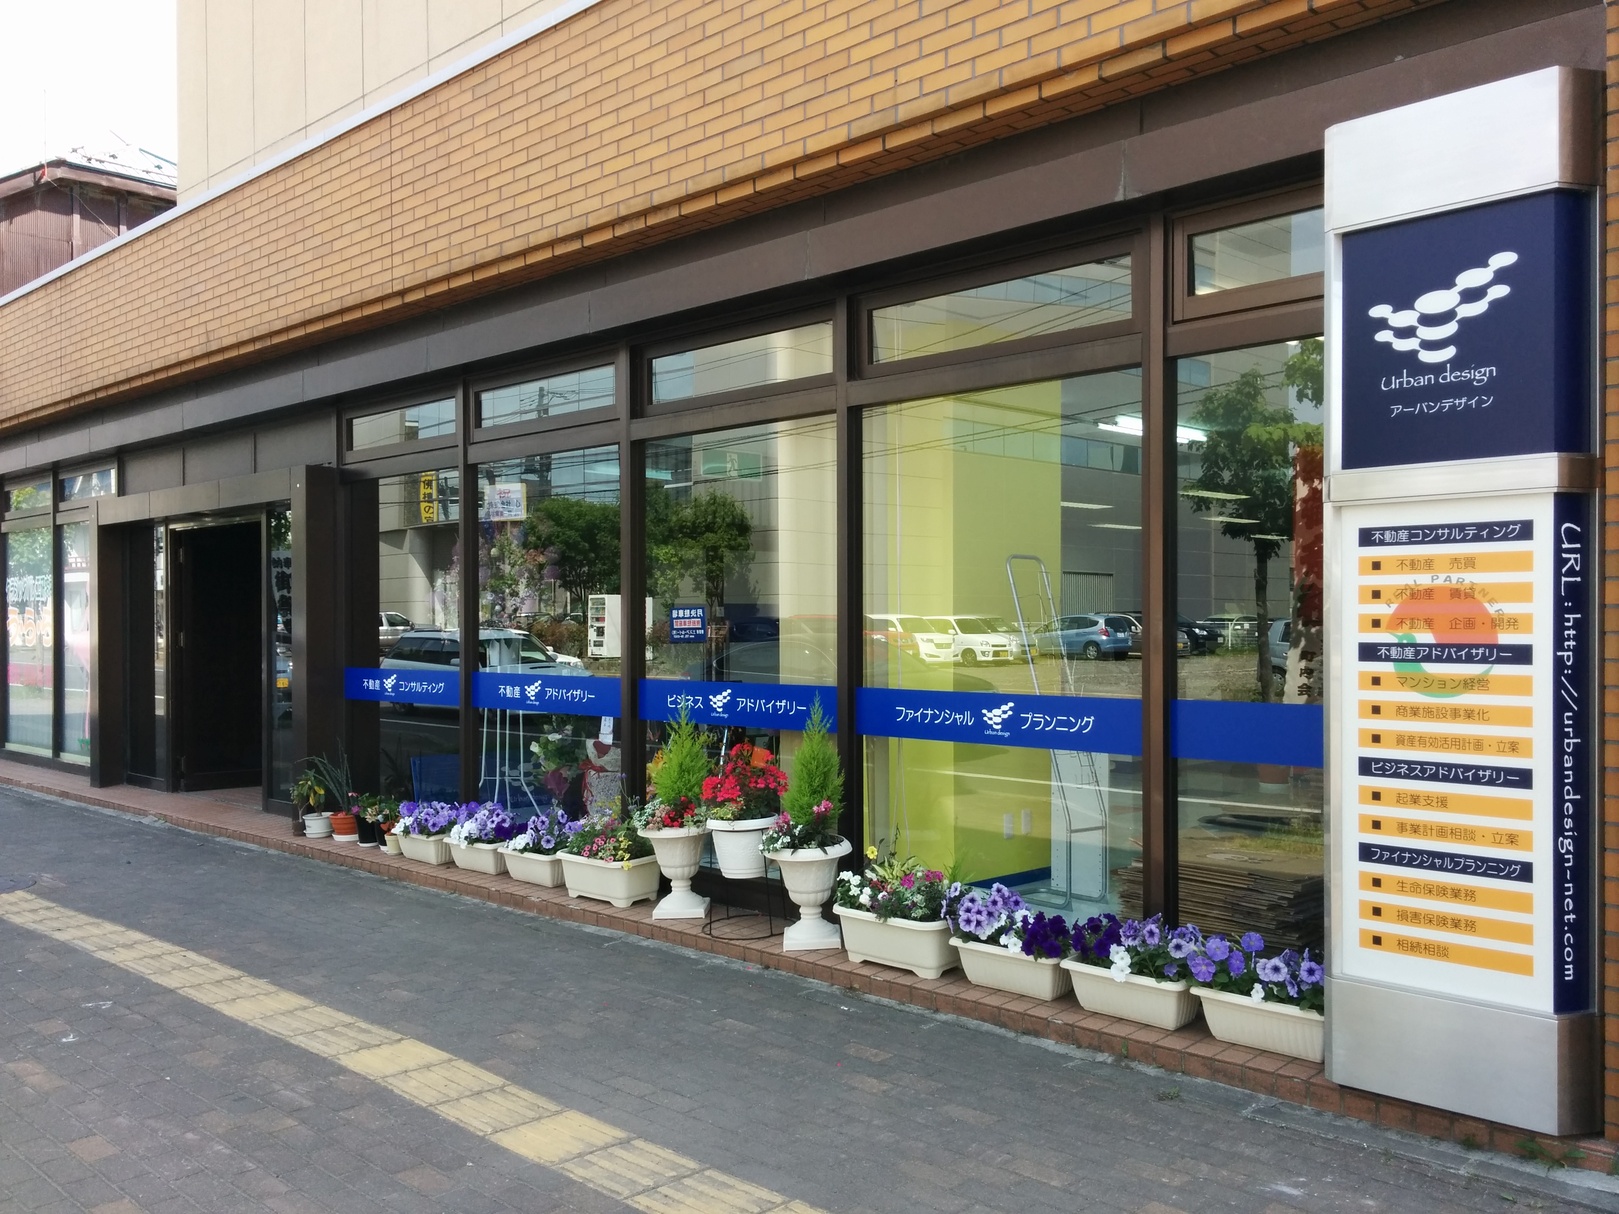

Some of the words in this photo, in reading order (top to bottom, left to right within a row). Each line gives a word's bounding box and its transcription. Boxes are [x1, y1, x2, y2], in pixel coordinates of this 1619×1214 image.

[1381, 369, 1434, 391] Urban
[1439, 364, 1496, 386] design
[1390, 395, 1494, 418] アーバンデザイン
[1371, 524, 1521, 543] 不動産コンサルティング
[1396, 558, 1435, 571] 不動産
[1449, 557, 1477, 570] 売買
[1396, 587, 1435, 600] 不動産
[1449, 586, 1477, 600] 賃貸
[1431, 574, 1505, 617] PARTNER
[1396, 617, 1435, 630] 不動産
[1449, 617, 1519, 630] 企画・開発
[1377, 646, 1513, 661] 不動産アドバイザリー
[363, 679, 381, 691] 不動産
[399, 681, 445, 694] コンサルティング
[1396, 675, 1490, 691] マンション経営
[498, 685, 521, 699] 不動産
[545, 687, 596, 703] アドバイザリー
[667, 694, 704, 709] ビジネス
[736, 697, 807, 715] アドバイザリー
[1396, 705, 1490, 722] 商業施設事業化
[896, 706, 975, 726] ファイナンシャル
[1020, 712, 1095, 733] プランニング
[1395, 734, 1519, 754] 資産有効活用計画・立案
[1371, 761, 1520, 784] ビジネスアドバイザリー
[1396, 792, 1449, 809] 起業支援
[1396, 821, 1519, 846] 事業計画相談・立案
[1371, 848, 1521, 877] ファイナンシャルプランニング
[1396, 880, 1477, 903] 生命保険業務
[1396, 909, 1477, 933] 損害保険業務
[1396, 939, 1450, 959] 相続相談
